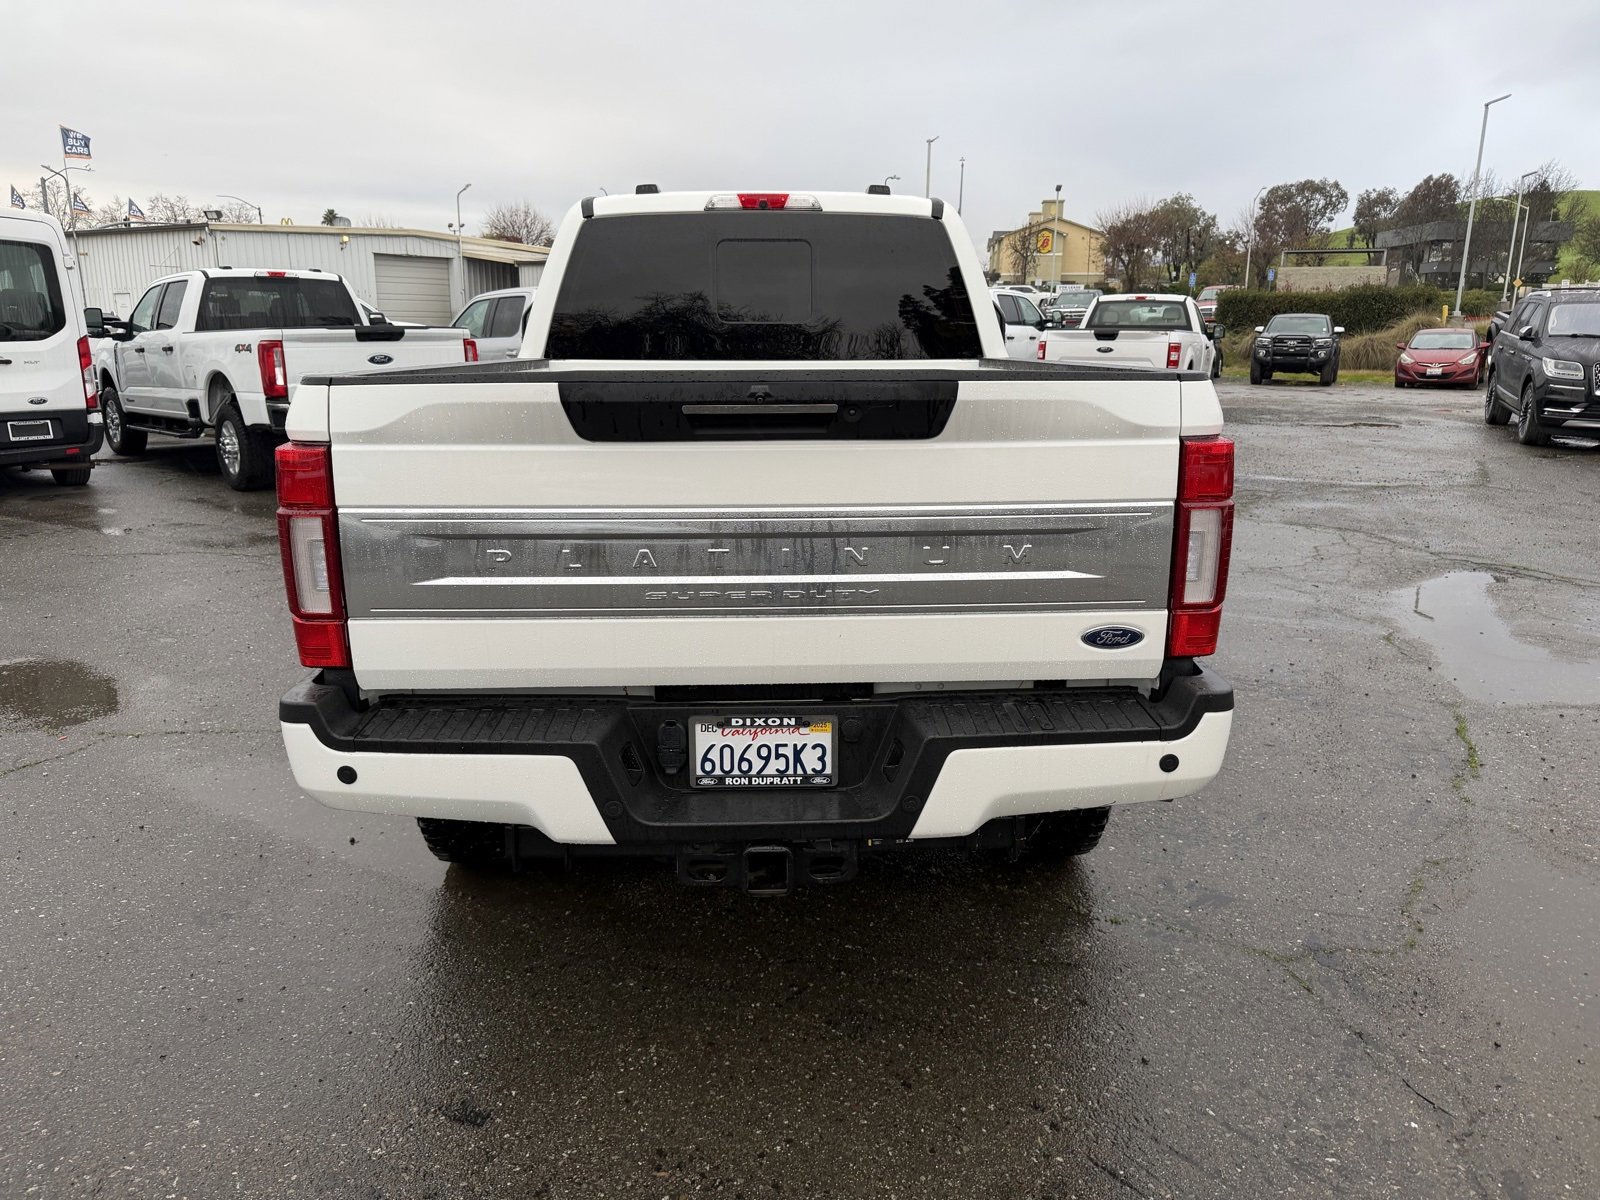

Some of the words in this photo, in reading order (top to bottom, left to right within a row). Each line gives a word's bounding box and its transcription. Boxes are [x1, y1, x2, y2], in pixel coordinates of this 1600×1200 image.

[67, 138, 85, 146] BUY
[65, 146, 89, 154] CARS
[487, 544, 1032, 571] PLATINUM
[646, 590, 773, 601] SUPER
[783, 588, 880, 600] DUTY
[1097, 630, 1131, 644] Ford
[731, 717, 796, 726] DIXON
[700, 723, 717, 733] DEC
[700, 743, 827, 775] 60695K3
[725, 777, 748, 785] RON
[752, 776, 803, 785] DUPRATT
